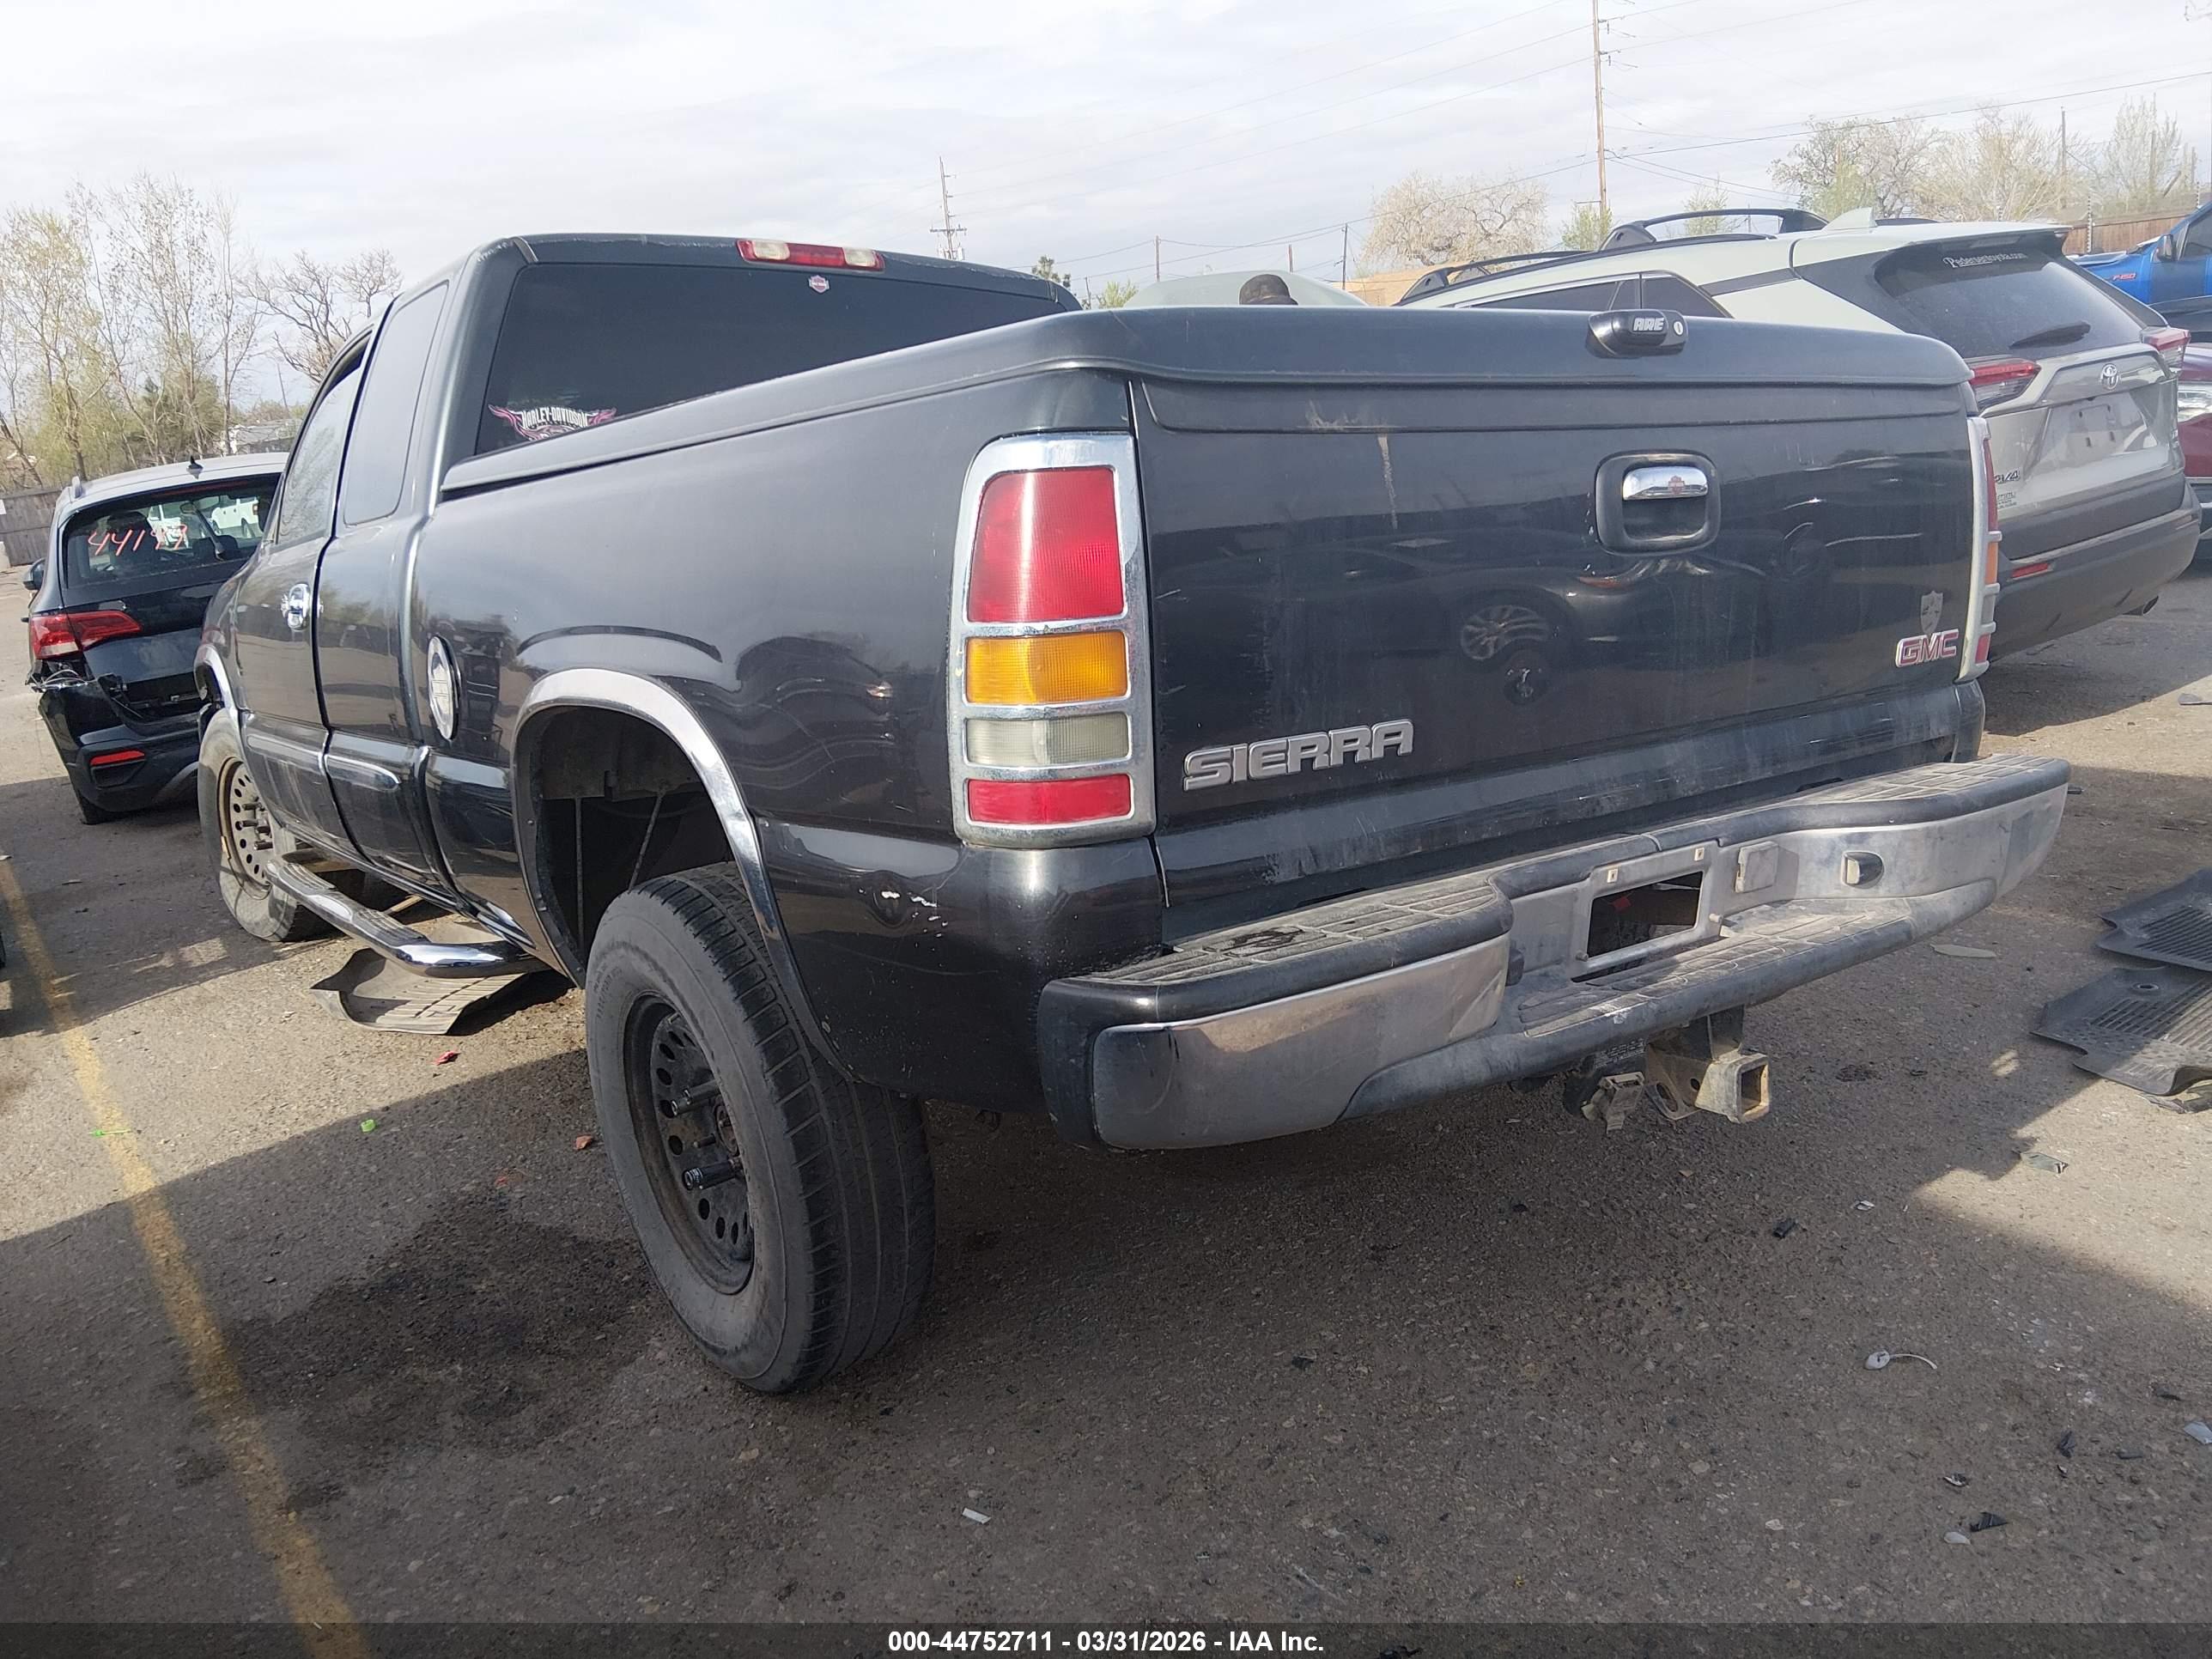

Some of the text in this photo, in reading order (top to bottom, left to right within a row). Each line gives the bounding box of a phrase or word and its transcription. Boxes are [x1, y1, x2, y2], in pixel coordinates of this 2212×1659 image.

[1632, 317, 1665, 331] ARE
[521, 406, 588, 429] HARLEY-DAVIDSON
[1896, 629, 1959, 667] GMC
[1183, 718, 1414, 792] SIERRA
